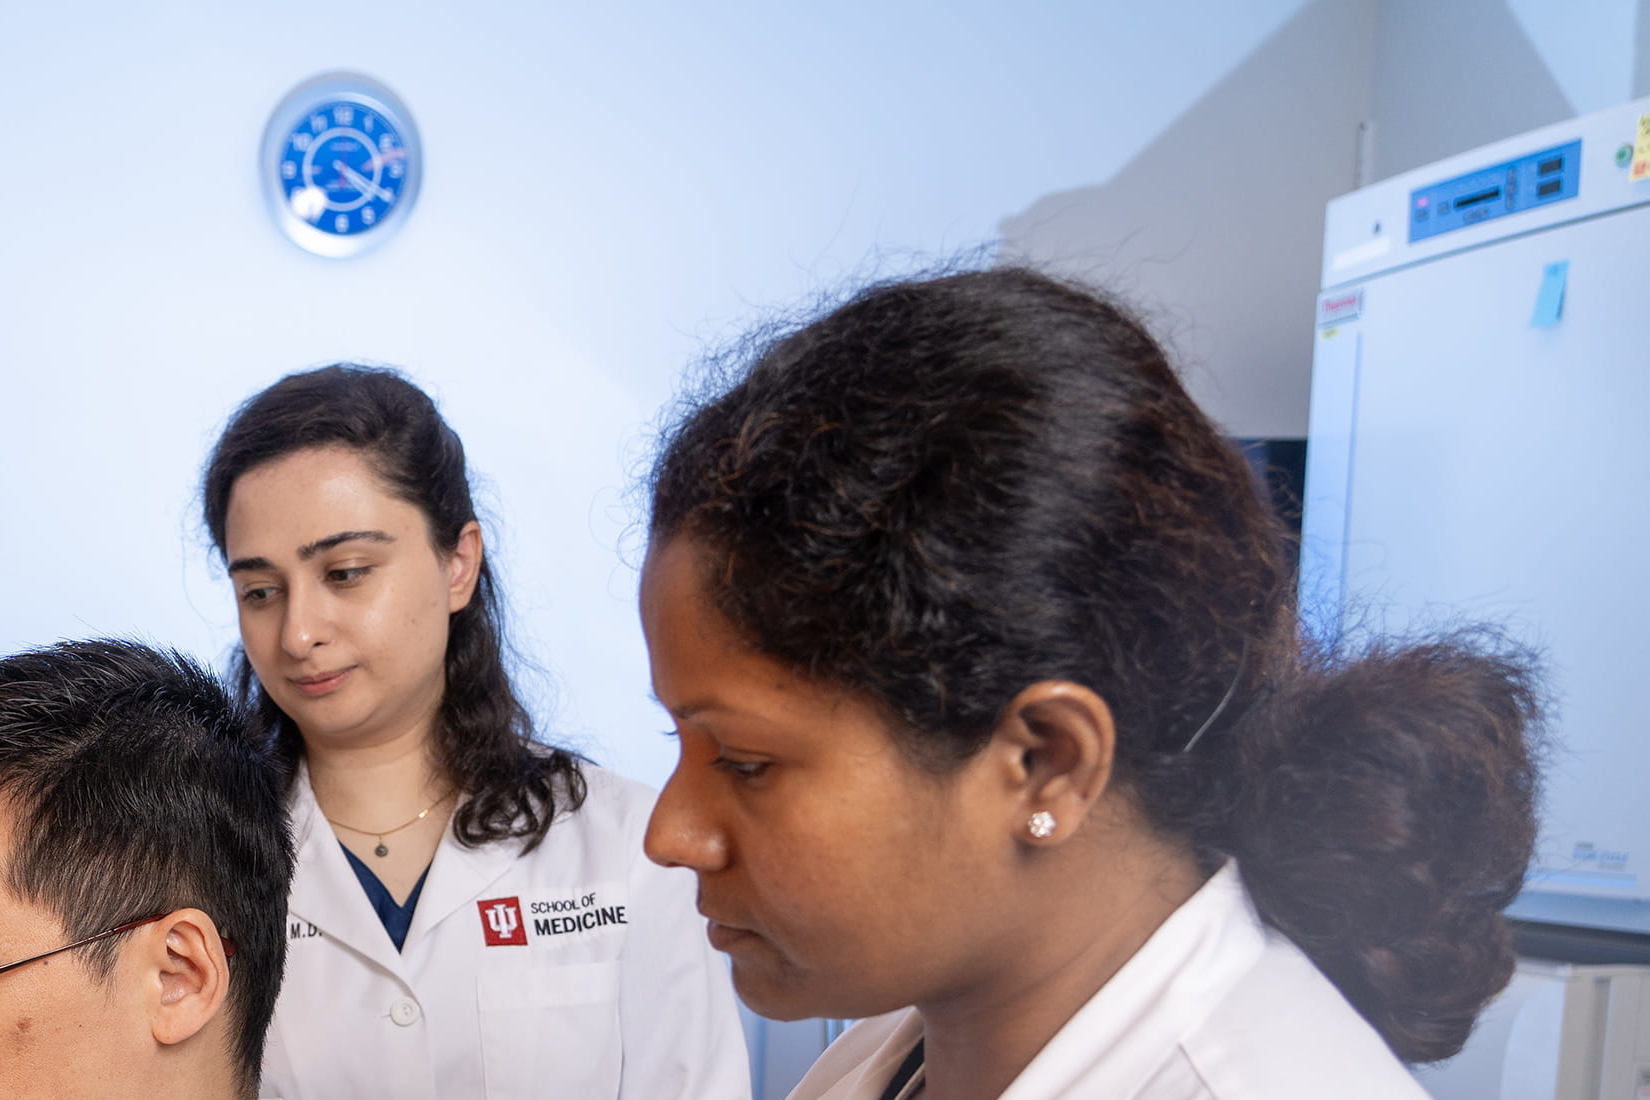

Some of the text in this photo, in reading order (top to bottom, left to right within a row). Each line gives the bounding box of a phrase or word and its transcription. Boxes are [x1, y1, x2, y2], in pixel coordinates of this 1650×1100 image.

[530, 892, 596, 914] SCHOOL OF
[290, 921, 323, 940] M.D.
[533, 905, 629, 937] MEDICINE
